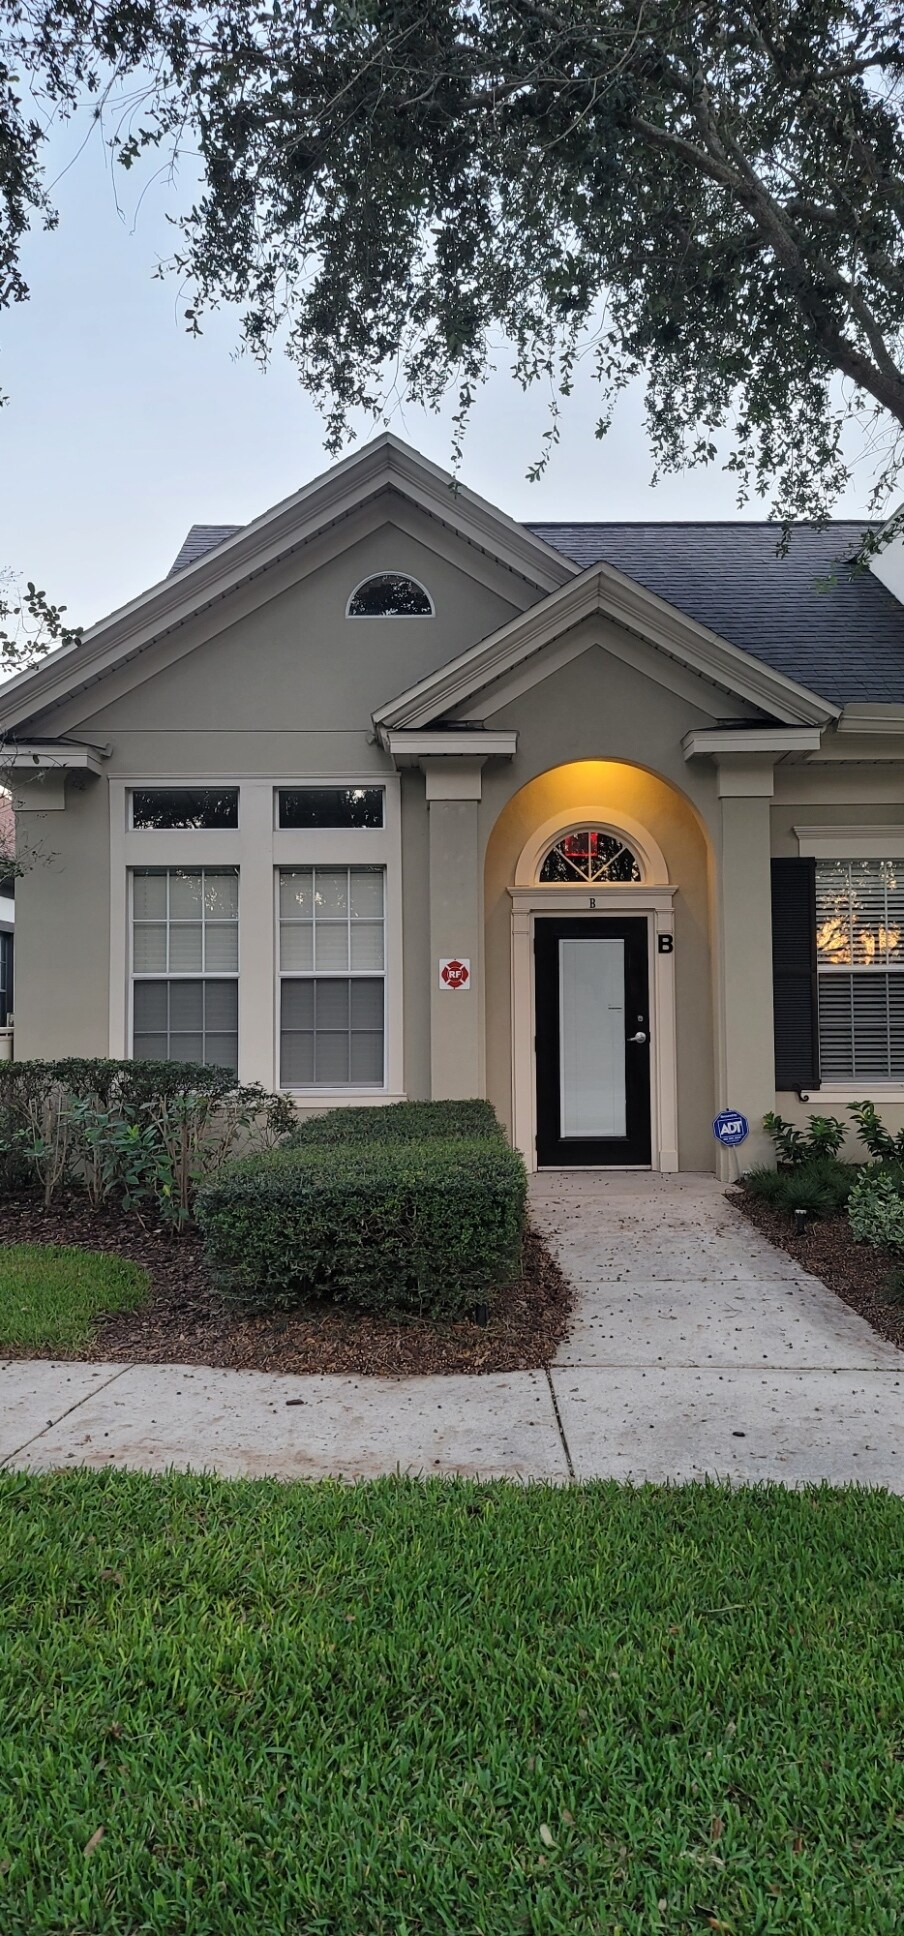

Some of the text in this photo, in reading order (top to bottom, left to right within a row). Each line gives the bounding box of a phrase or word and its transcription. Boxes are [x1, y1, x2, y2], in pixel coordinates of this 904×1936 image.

[589, 898, 596, 908] B
[658, 934, 673, 954] B
[449, 970, 461, 978] RF
[720, 1121, 742, 1135] ADT
